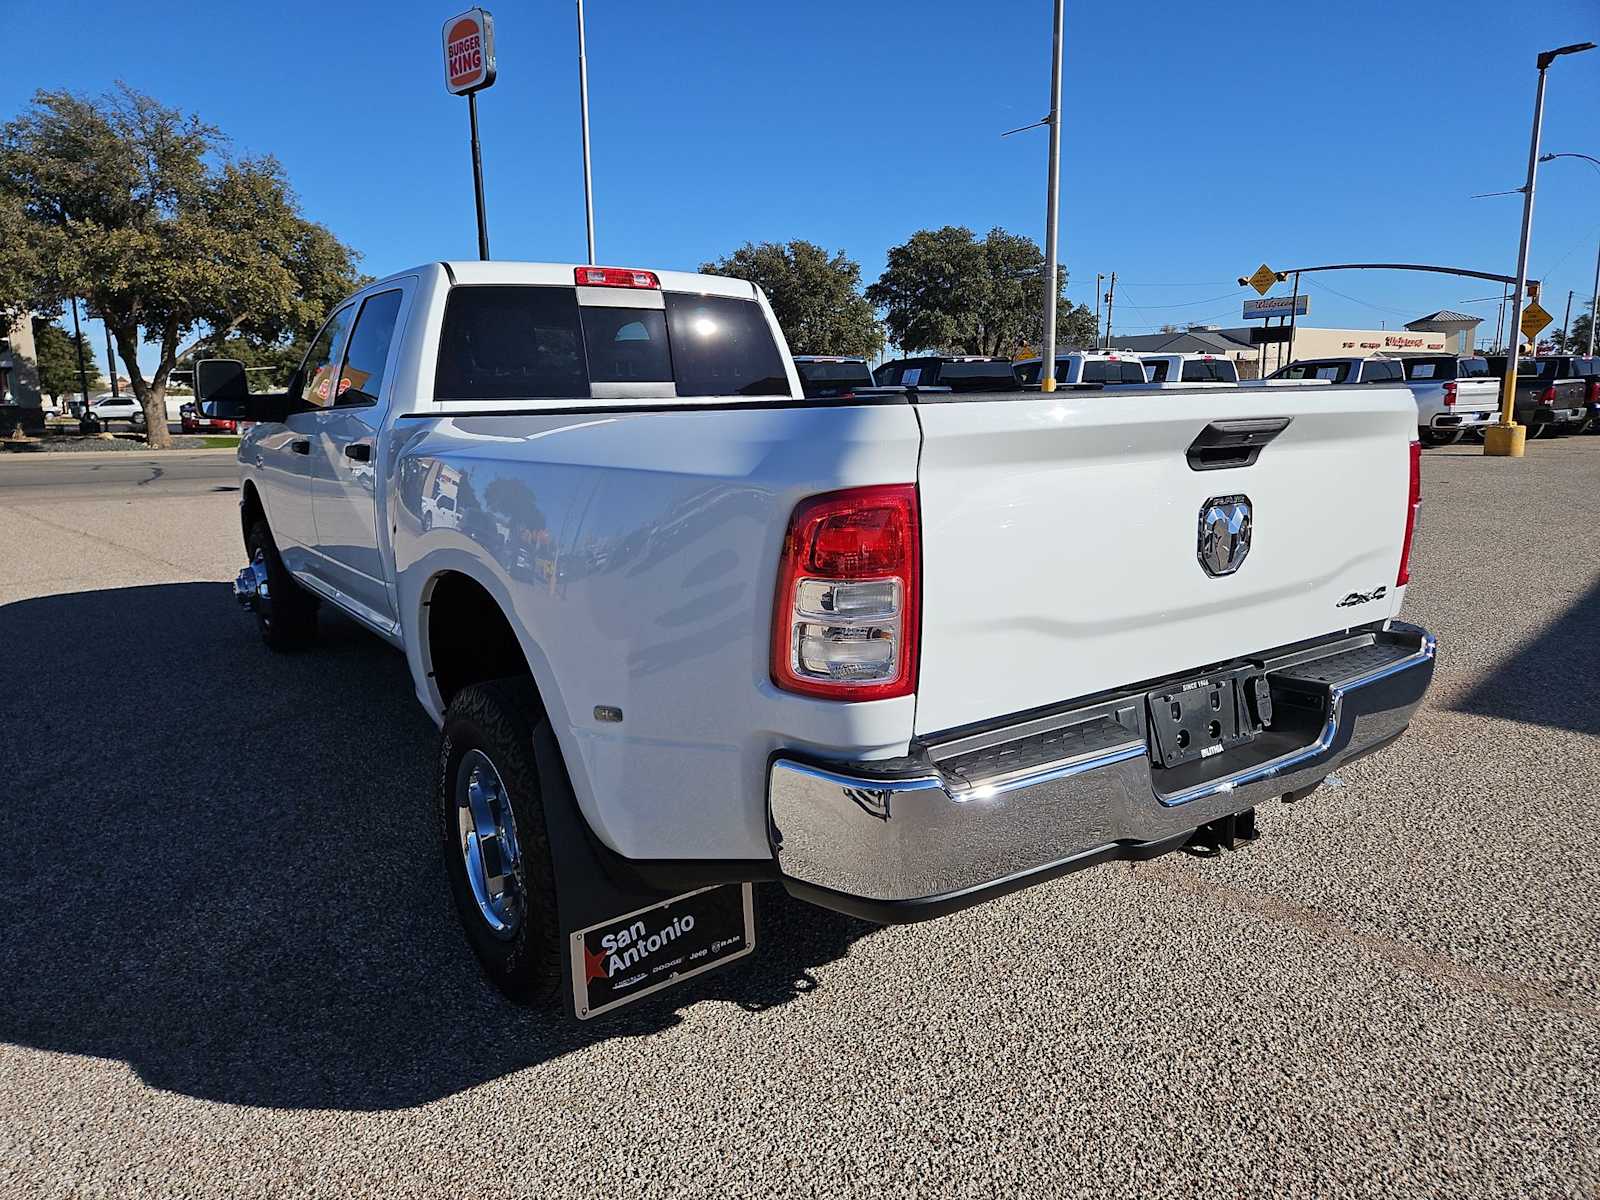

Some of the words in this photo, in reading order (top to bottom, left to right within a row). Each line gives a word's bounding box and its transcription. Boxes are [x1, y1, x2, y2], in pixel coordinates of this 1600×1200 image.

[448, 36, 480, 57] BURGER
[449, 50, 481, 77] KING
[1255, 300, 1299, 309] Walgreen
[1182, 682, 1198, 691] SINCE
[601, 921, 646, 954] San
[608, 915, 695, 977] Antonio
[652, 958, 683, 973] DODGE
[689, 948, 708, 960] Jeep
[720, 935, 740, 947] RAM
